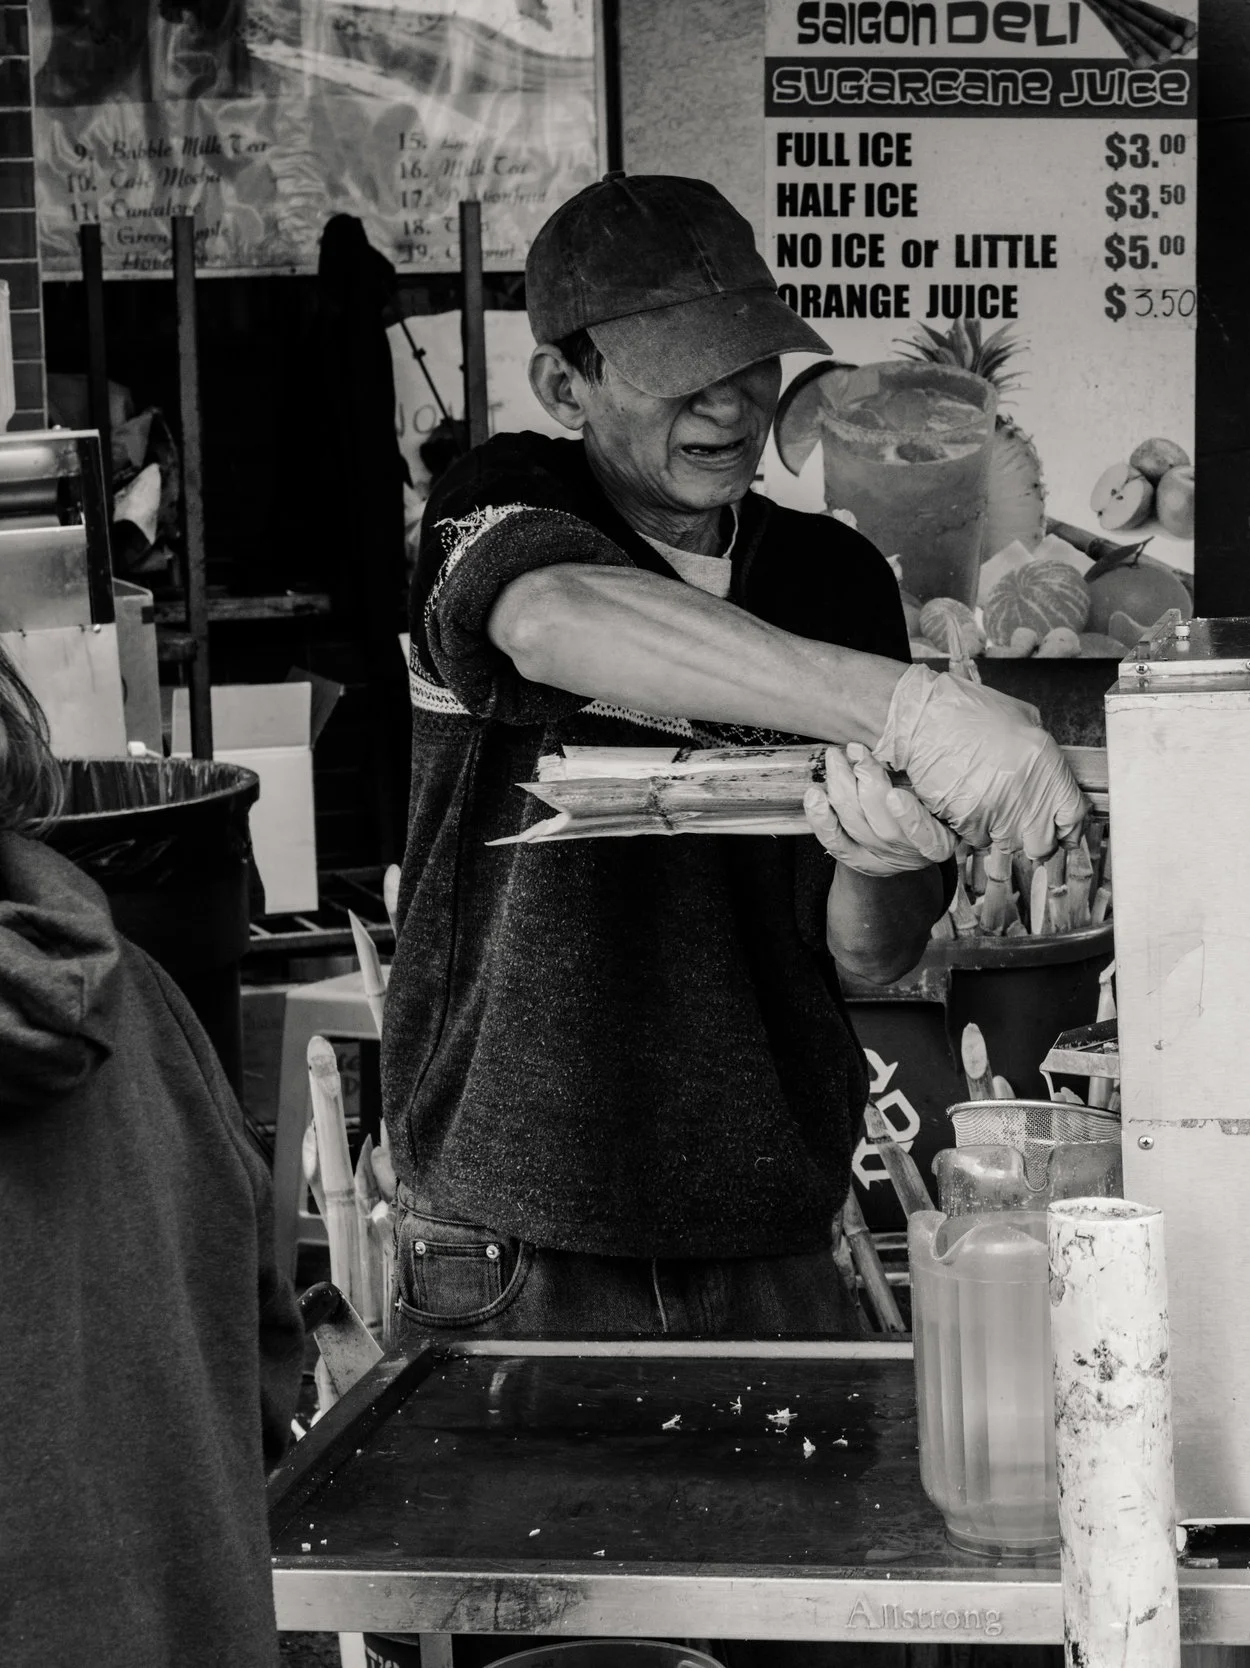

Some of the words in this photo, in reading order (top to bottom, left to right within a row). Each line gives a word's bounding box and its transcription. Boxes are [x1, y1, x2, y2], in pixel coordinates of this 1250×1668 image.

[777, 132, 849, 167] FULL
[859, 132, 912, 167] ICE
[777, 183, 856, 217] HALF
[864, 183, 917, 217] ICE
[777, 233, 821, 268] NO
[832, 233, 885, 268] ICE
[902, 238, 938, 268] or
[956, 234, 1056, 268] LITTLE
[926, 284, 1018, 318] JUICE
[845, 1591, 1003, 1636] Allstrong
